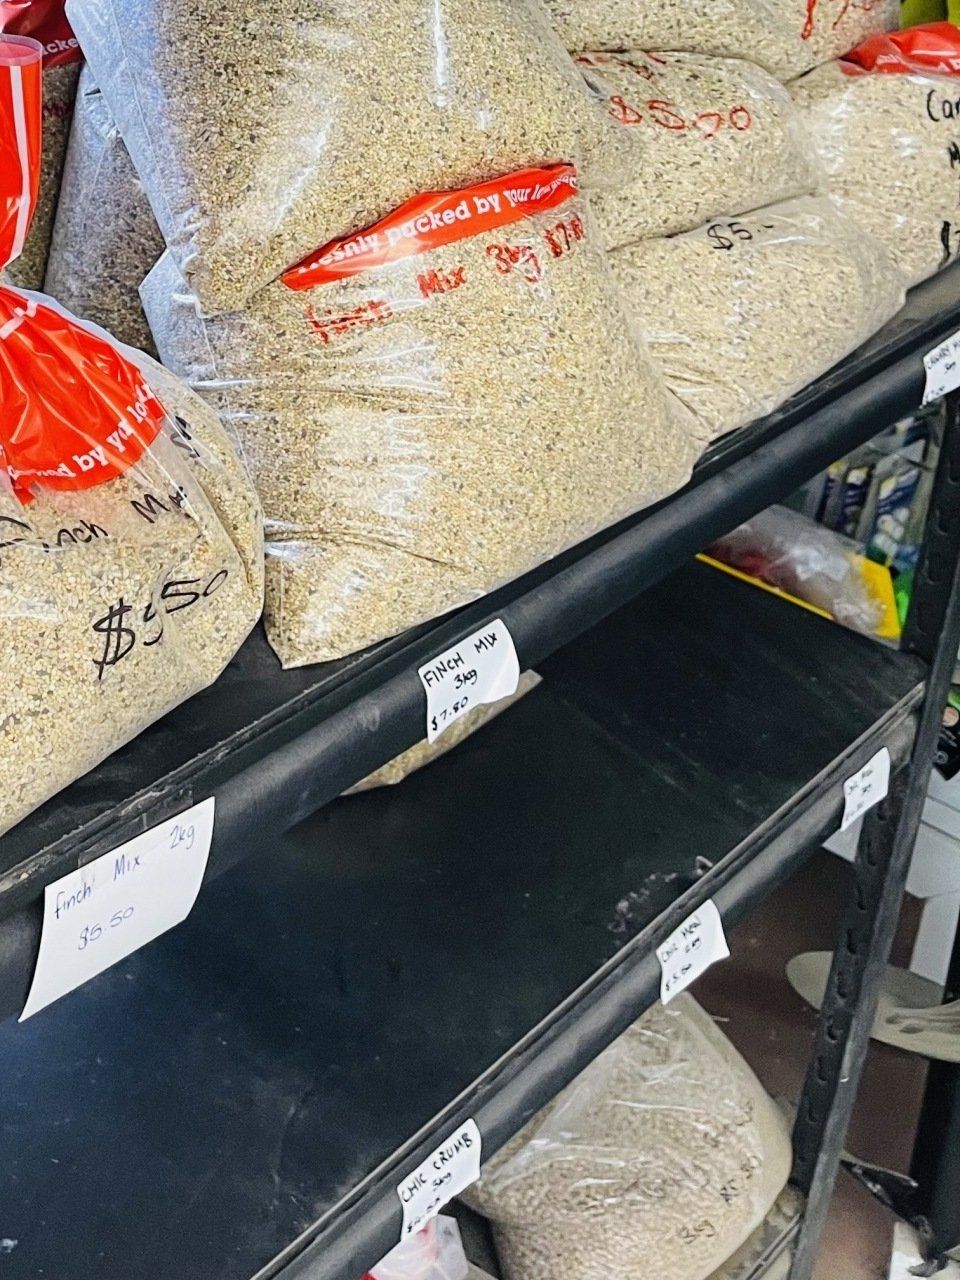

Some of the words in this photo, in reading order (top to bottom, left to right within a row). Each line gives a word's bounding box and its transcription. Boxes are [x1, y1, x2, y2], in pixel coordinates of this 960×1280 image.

[383, 200, 472, 245] packed
[473, 193, 500, 215] by
[71, 444, 109, 472] by
[423, 652, 464, 687] FINCH
[474, 632, 498, 653] MIX
[113, 854, 141, 881] Mix
[170, 825, 196, 850] 2kg
[401, 1173, 428, 1203] CHIC
